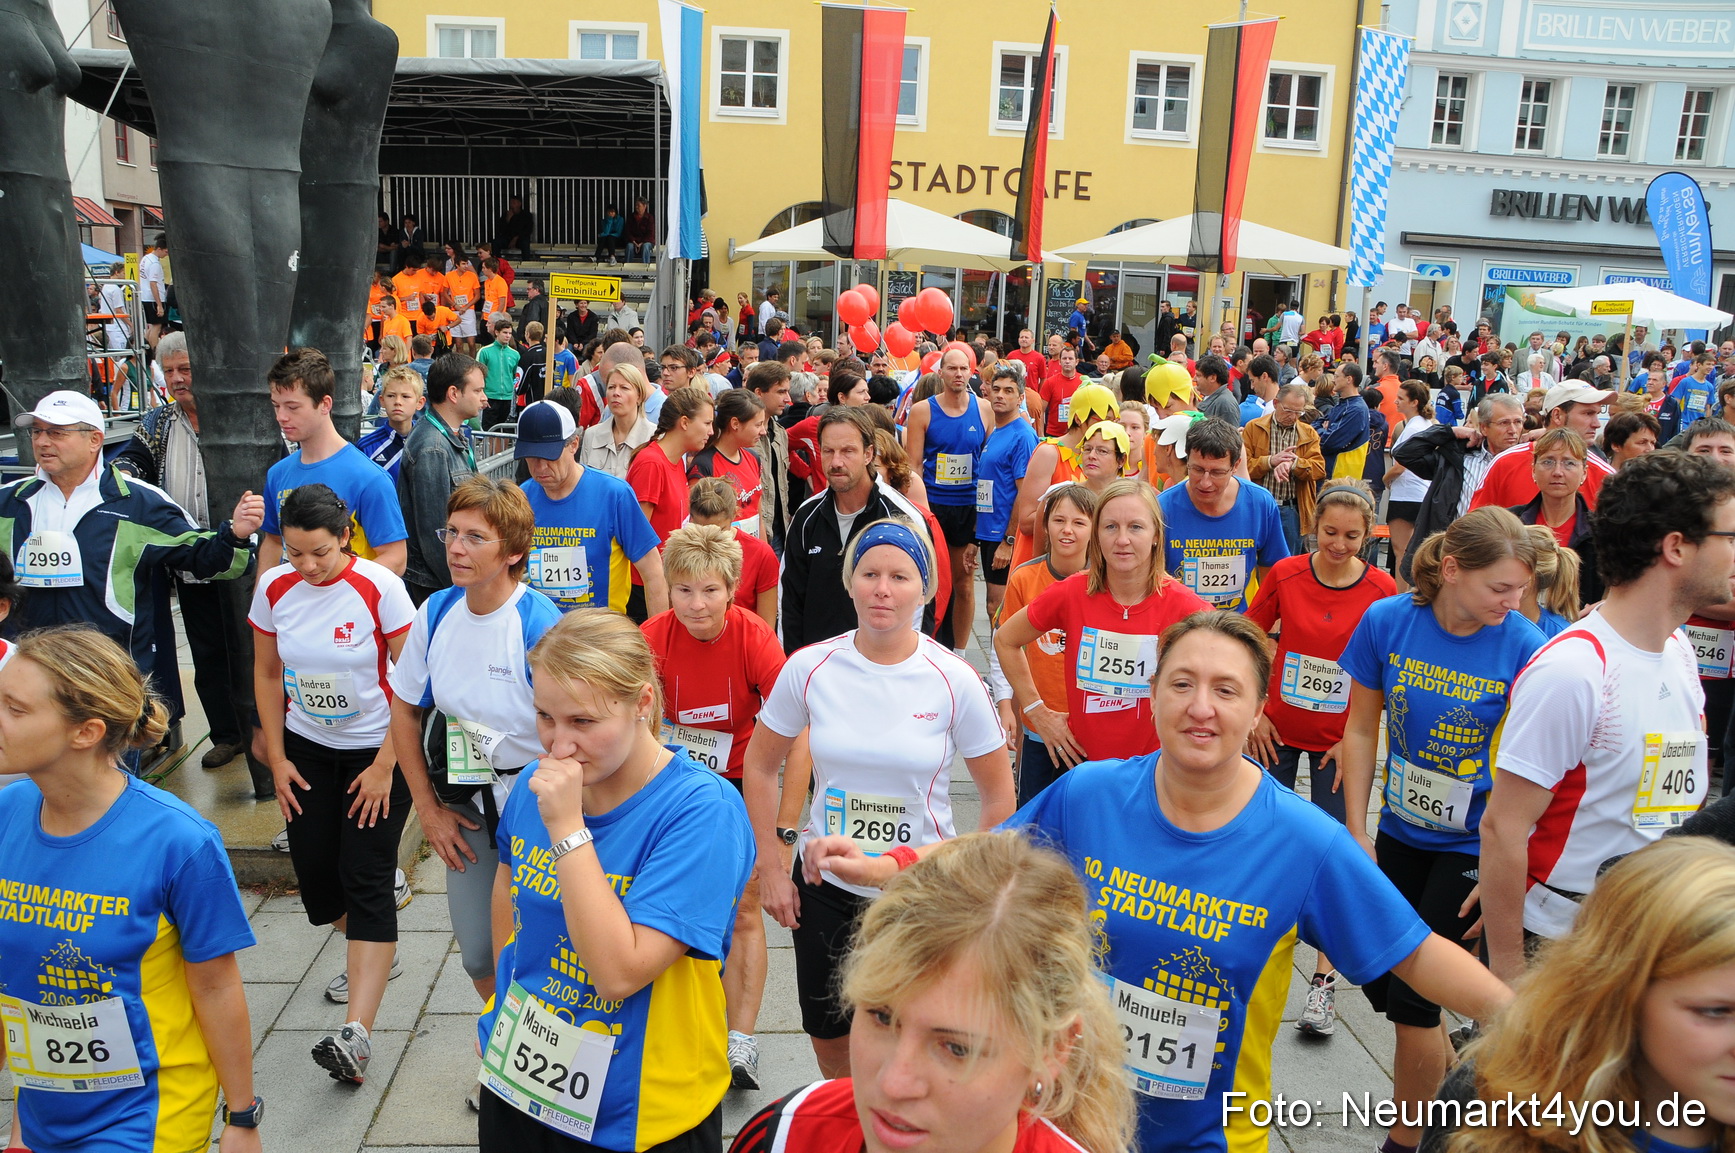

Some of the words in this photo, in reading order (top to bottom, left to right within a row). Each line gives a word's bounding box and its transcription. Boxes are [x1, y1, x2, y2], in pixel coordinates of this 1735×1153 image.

[1536, 12, 1635, 41] BRILLEN
[1640, 17, 1732, 44] WEBER
[888, 160, 1093, 201] STADTCFE
[1490, 189, 1603, 222] BRILLEN
[566, 279, 597, 287] Treffpunkt
[1492, 268, 1532, 281] BRILLEN
[1533, 270, 1568, 283] WEBER
[554, 285, 607, 297] Bambinilauf
[950, 465, 968, 475] 212
[533, 526, 596, 538] NEUMARKTER
[1170, 539, 1184, 548] 10.
[1185, 538, 1255, 549] NEUMARKTER
[29, 551, 72, 567] 2999
[544, 552, 559, 563] Otto
[1183, 548, 1241, 558] STADTLAUF
[1201, 561, 1230, 570] Thomas
[545, 567, 582, 582] 2113
[1201, 573, 1236, 587] 3221
[1100, 636, 1119, 651] Lisa
[1687, 629, 1719, 642] Michael
[1082, 651, 1088, 660] D
[1691, 644, 1726, 661] 546
[488, 664, 513, 676] Spangler
[1098, 656, 1145, 677] 2551
[1303, 659, 1344, 676] Stephanie
[300, 678, 331, 690] Andrea
[1302, 675, 1343, 694] 2692
[1403, 657, 1506, 695] NEUMARKTER
[1397, 670, 1483, 703] STADTLAUF
[304, 693, 349, 709] 3208
[1099, 698, 1123, 708] DEHN
[692, 711, 715, 720] DEHN
[451, 741, 457, 752] S
[677, 728, 718, 748] Elisabeth
[1426, 739, 1482, 758] 20.09.2009
[1662, 740, 1696, 758] Joachim
[688, 749, 718, 770] 550
[1407, 770, 1432, 788] Julia
[1662, 769, 1695, 795] 406
[851, 798, 906, 814] Christine
[1408, 788, 1455, 822] 2661
[829, 815, 836, 826] C
[851, 819, 911, 844] 2696
[510, 835, 525, 859] 10.
[0, 879, 130, 916] NEUMARKTER
[1084, 856, 1105, 882] 10.
[1108, 866, 1269, 929] NEUMARKTER
[0, 900, 95, 934] TADTLAUF
[1096, 886, 1232, 943] STADTLAUF
[541, 975, 625, 1014] 20.09.2009
[1117, 989, 1187, 1028] Manuela
[27, 1007, 99, 1030] Michaela
[522, 1006, 560, 1047] Maria
[9, 1029, 16, 1043] D
[496, 1021, 504, 1037] S
[46, 1038, 110, 1064] 826
[87, 1073, 141, 1086] PFLEIDERER
[513, 1042, 590, 1100] 5220
[1151, 1081, 1204, 1096] PFLEIDERER
[541, 1105, 591, 1133] PFLEIDERER
